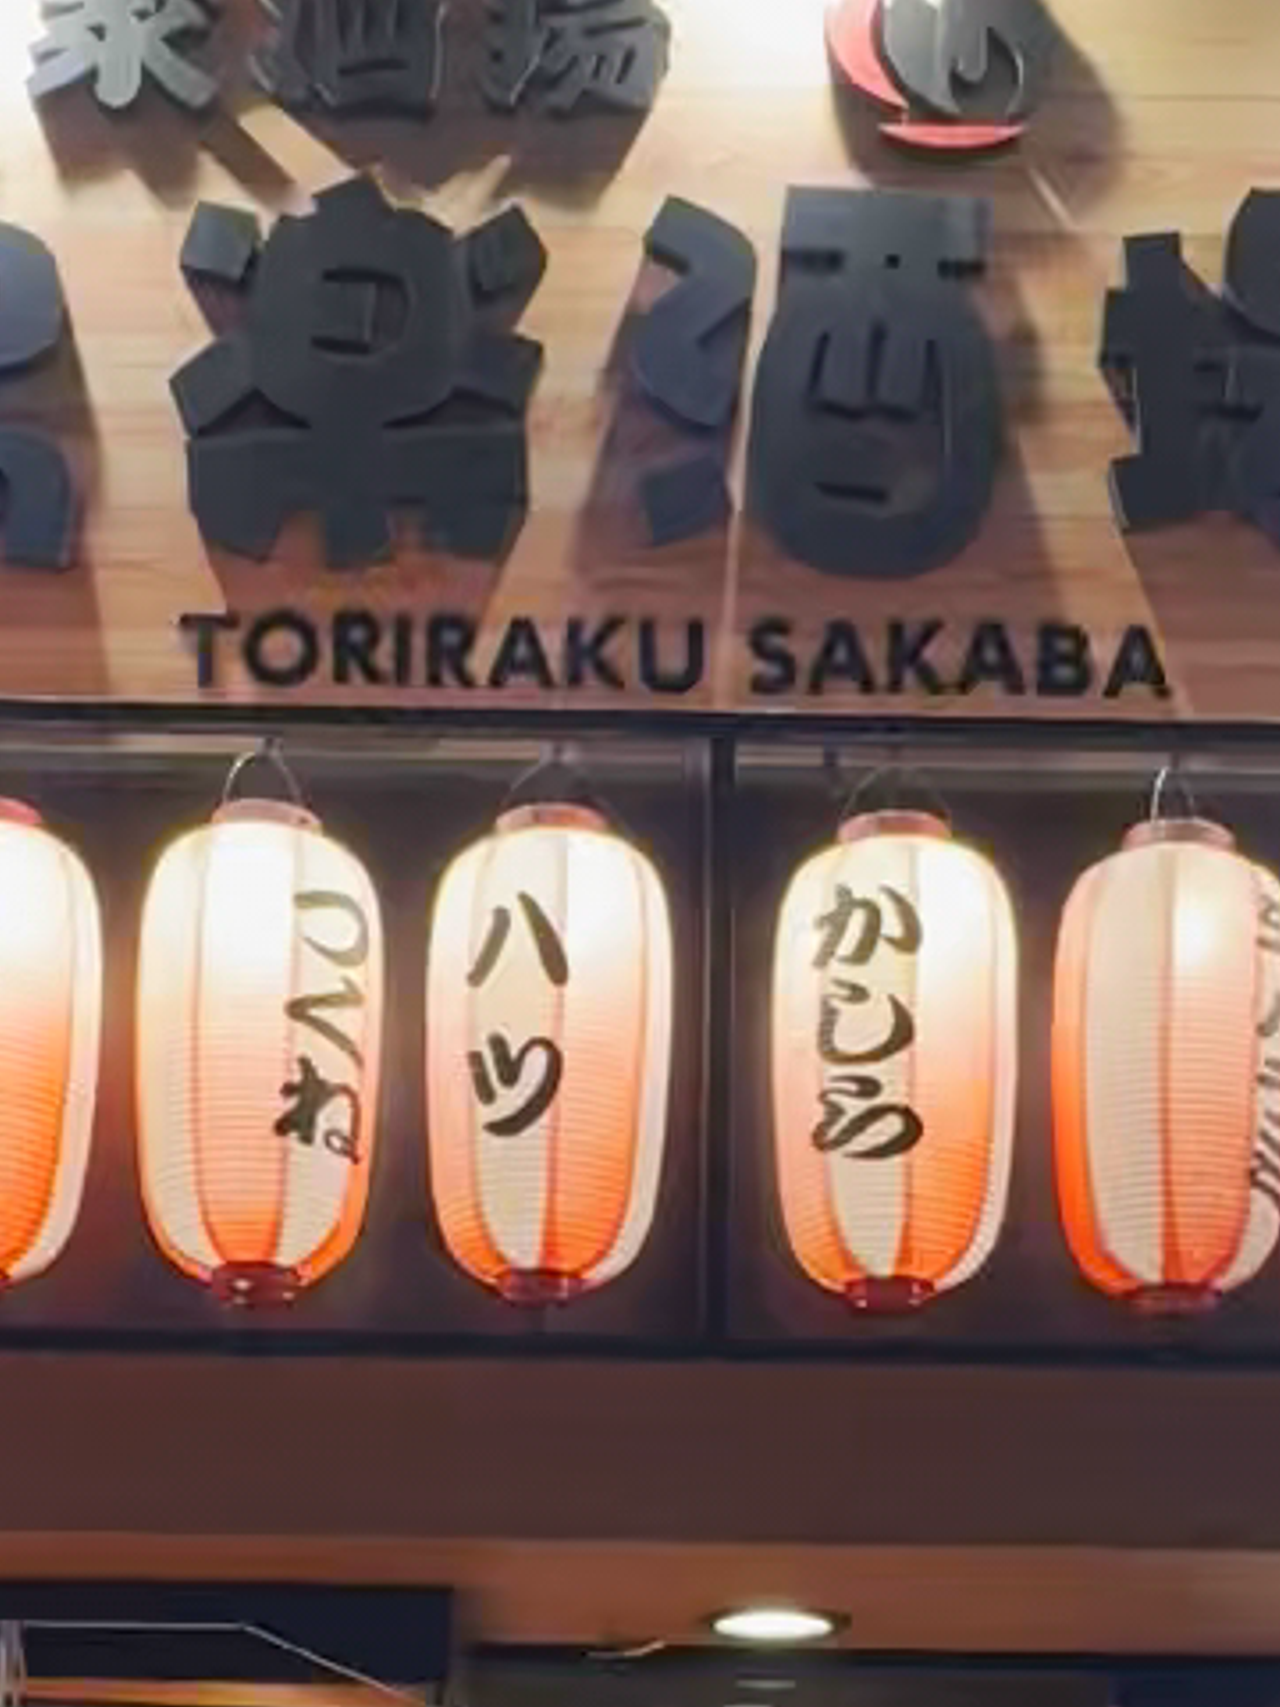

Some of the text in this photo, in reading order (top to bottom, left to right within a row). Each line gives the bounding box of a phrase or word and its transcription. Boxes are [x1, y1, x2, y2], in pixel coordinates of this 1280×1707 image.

[178, 611, 1176, 703] TORIRAKU SAKABA
[274, 887, 370, 1166] つくね
[465, 895, 570, 1141] ハツ
[810, 881, 924, 1159] かしら
